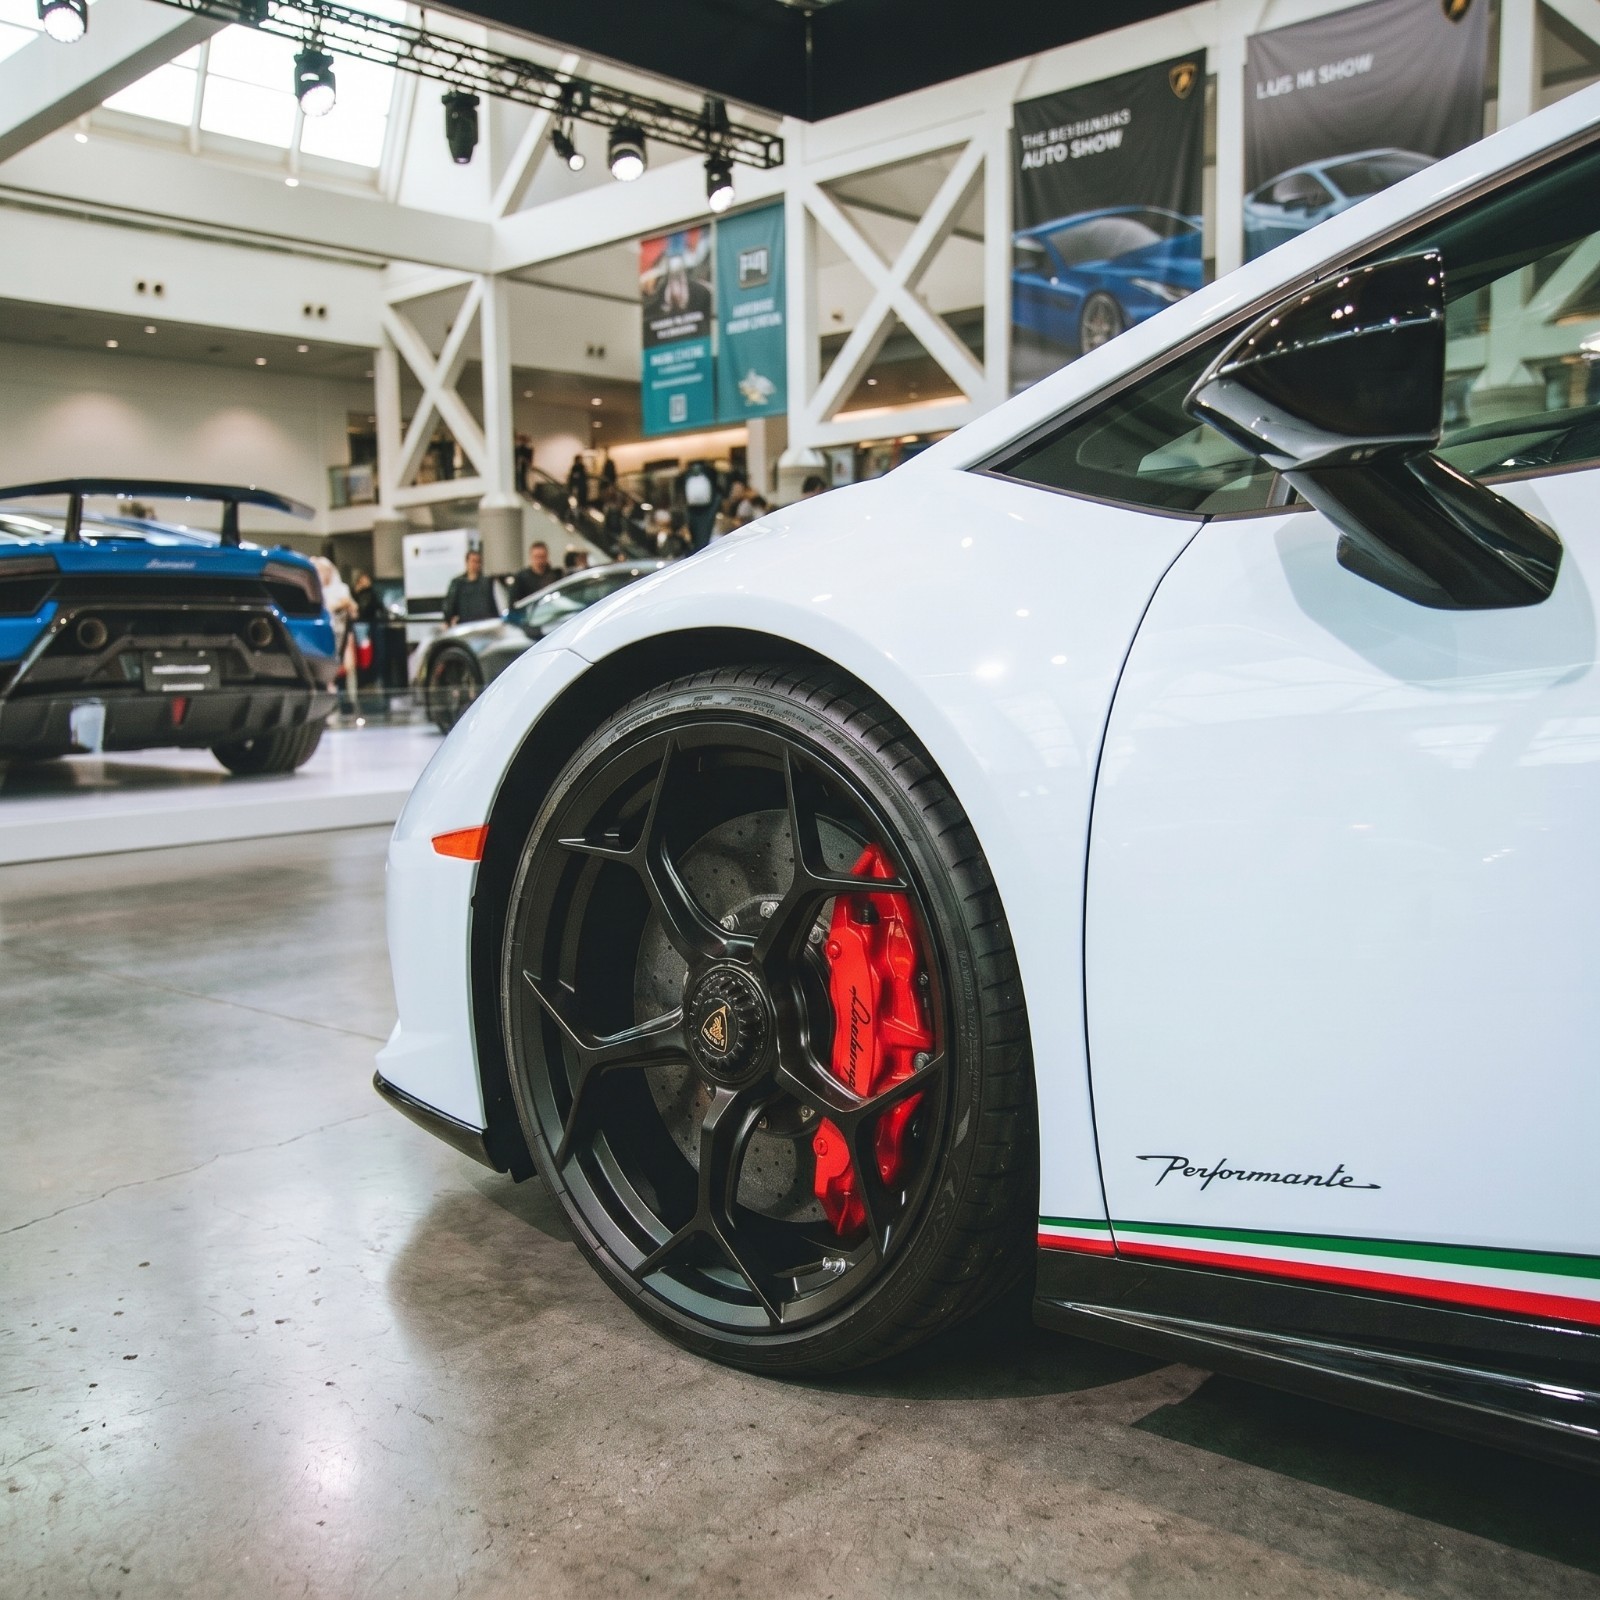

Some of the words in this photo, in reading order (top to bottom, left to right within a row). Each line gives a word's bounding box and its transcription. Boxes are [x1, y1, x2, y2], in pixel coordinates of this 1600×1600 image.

[1319, 53, 1373, 83] SHOW
[1021, 143, 1068, 170] AUTO
[1070, 129, 1123, 158] SHOW
[1136, 1155, 1381, 1190] Performante
